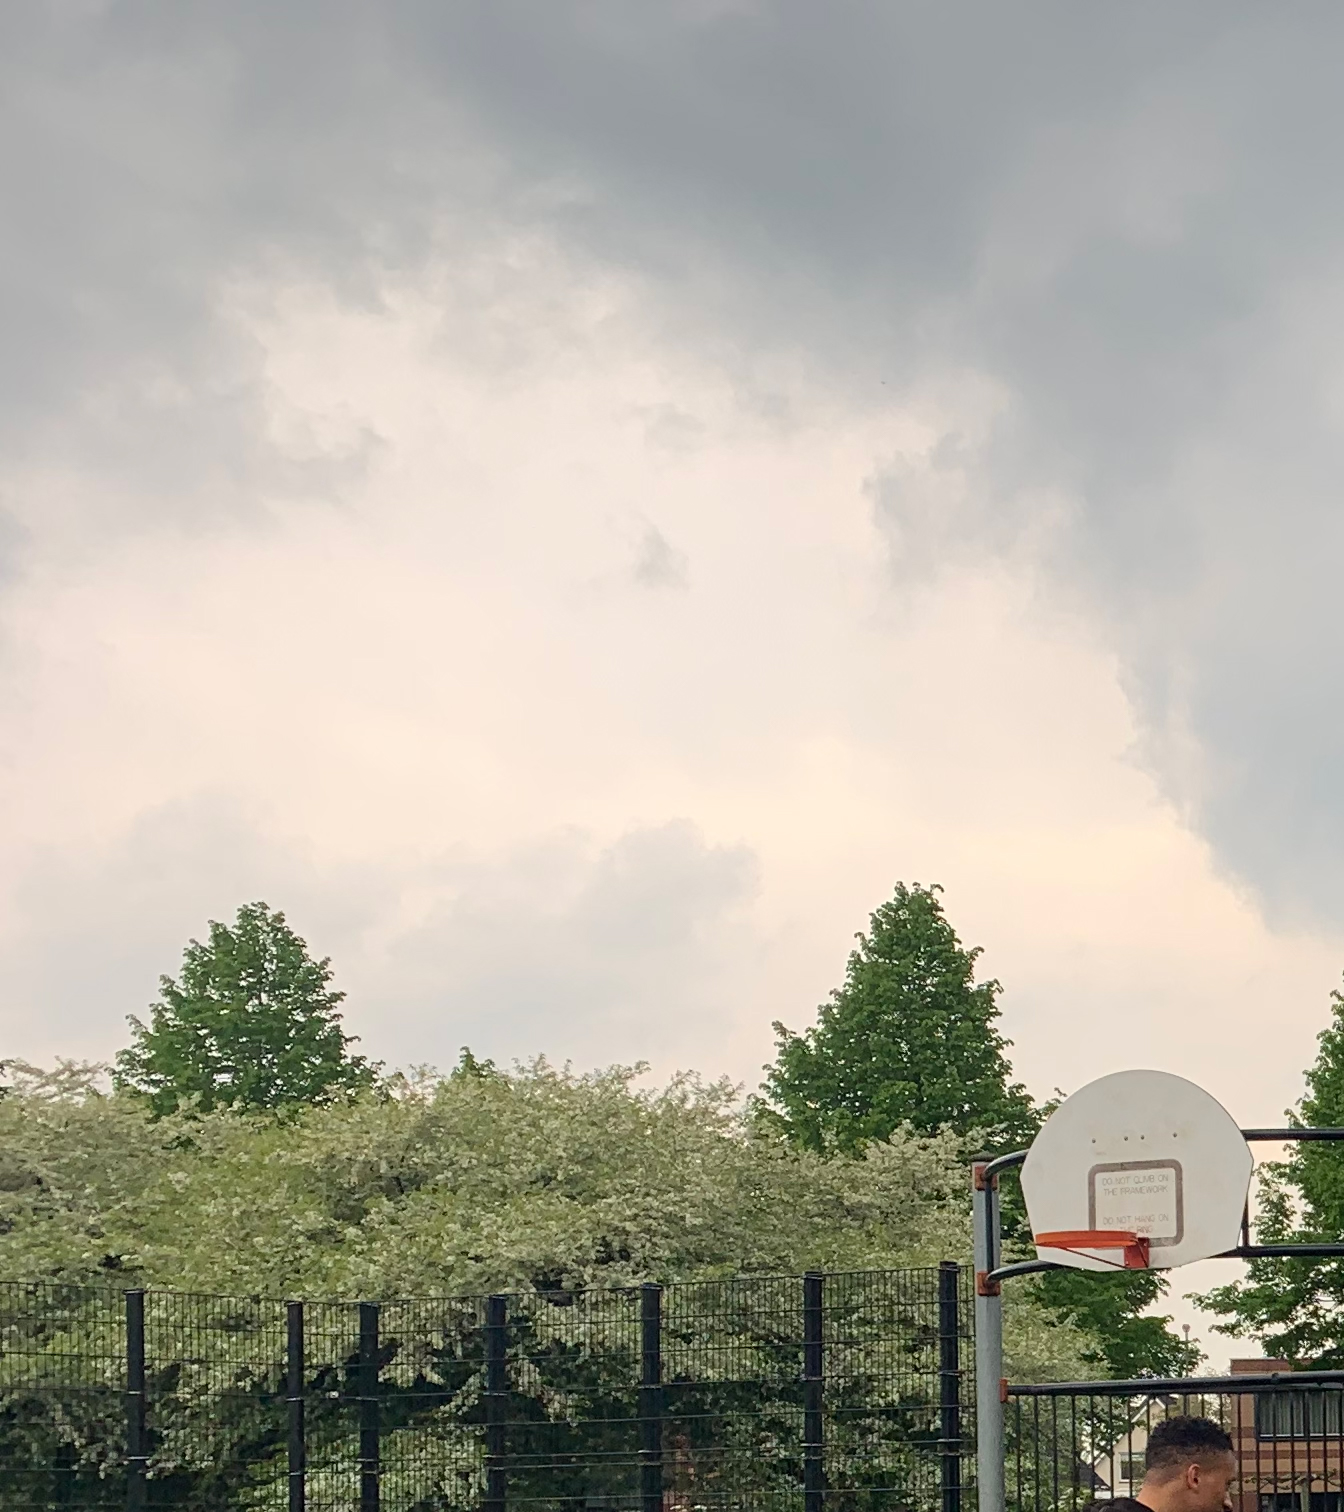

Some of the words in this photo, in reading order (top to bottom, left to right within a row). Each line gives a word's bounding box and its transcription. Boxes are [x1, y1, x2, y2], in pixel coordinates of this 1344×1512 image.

[1102, 1178, 1112, 1186] DO
[1115, 1176, 1131, 1184] NOT
[1133, 1174, 1154, 1184] CLIMB
[1158, 1174, 1168, 1182] ON
[1104, 1188, 1117, 1196] THE
[1121, 1185, 1168, 1195] FRAMEWORK
[1103, 1217, 1113, 1225] DO
[1117, 1216, 1132, 1224] NOT
[1135, 1214, 1154, 1223] HANG
[1158, 1213, 1168, 1222] ON
[1137, 1225, 1153, 1233] RING
